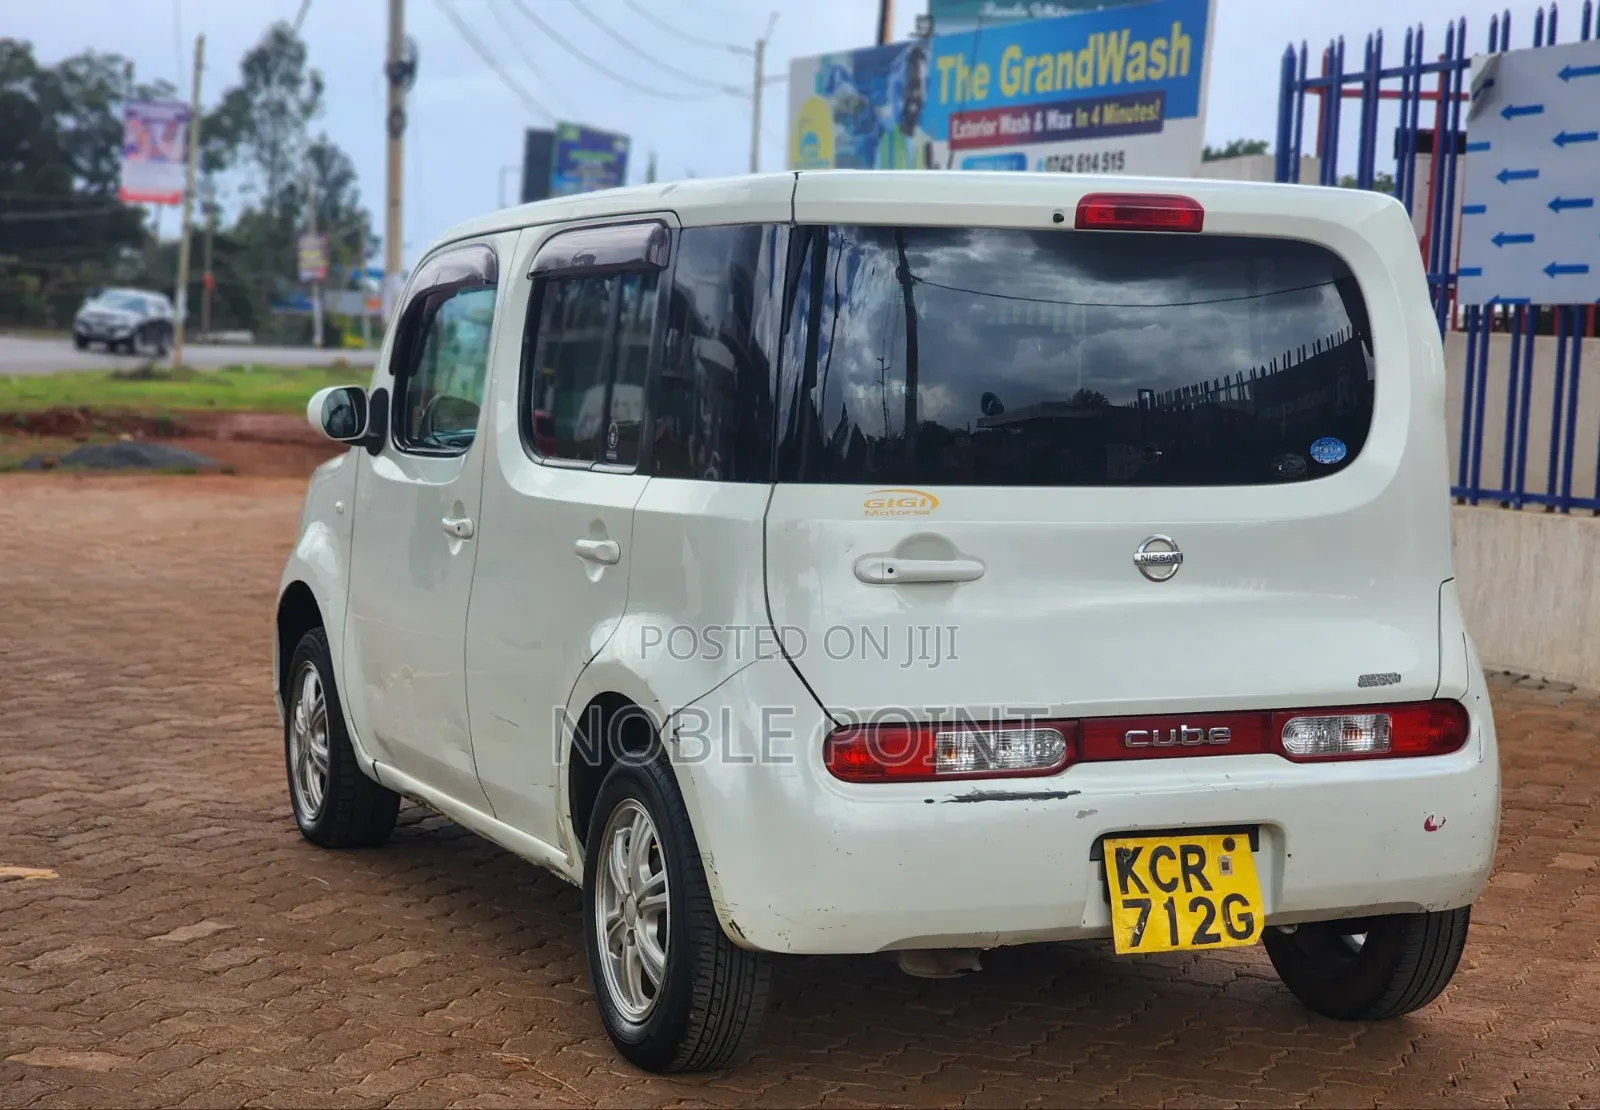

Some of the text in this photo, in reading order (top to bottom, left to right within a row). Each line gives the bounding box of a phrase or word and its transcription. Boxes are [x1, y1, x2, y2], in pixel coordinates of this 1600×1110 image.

[937, 20, 1191, 104] The GrandWash
[951, 119, 997, 140] Exterior
[999, 111, 1030, 135] Wash
[1033, 110, 1044, 132] &
[1046, 109, 1073, 131] Wax
[1091, 105, 1100, 125] 4
[1102, 98, 1161, 125] Minutes!
[1101, 150, 1125, 172] 515
[863, 498, 928, 509] GIGI
[1140, 553, 1179, 563] NISSAN
[1125, 724, 1232, 748] cube
[1114, 844, 1213, 895] KCR
[1122, 893, 1255, 948] 712G
